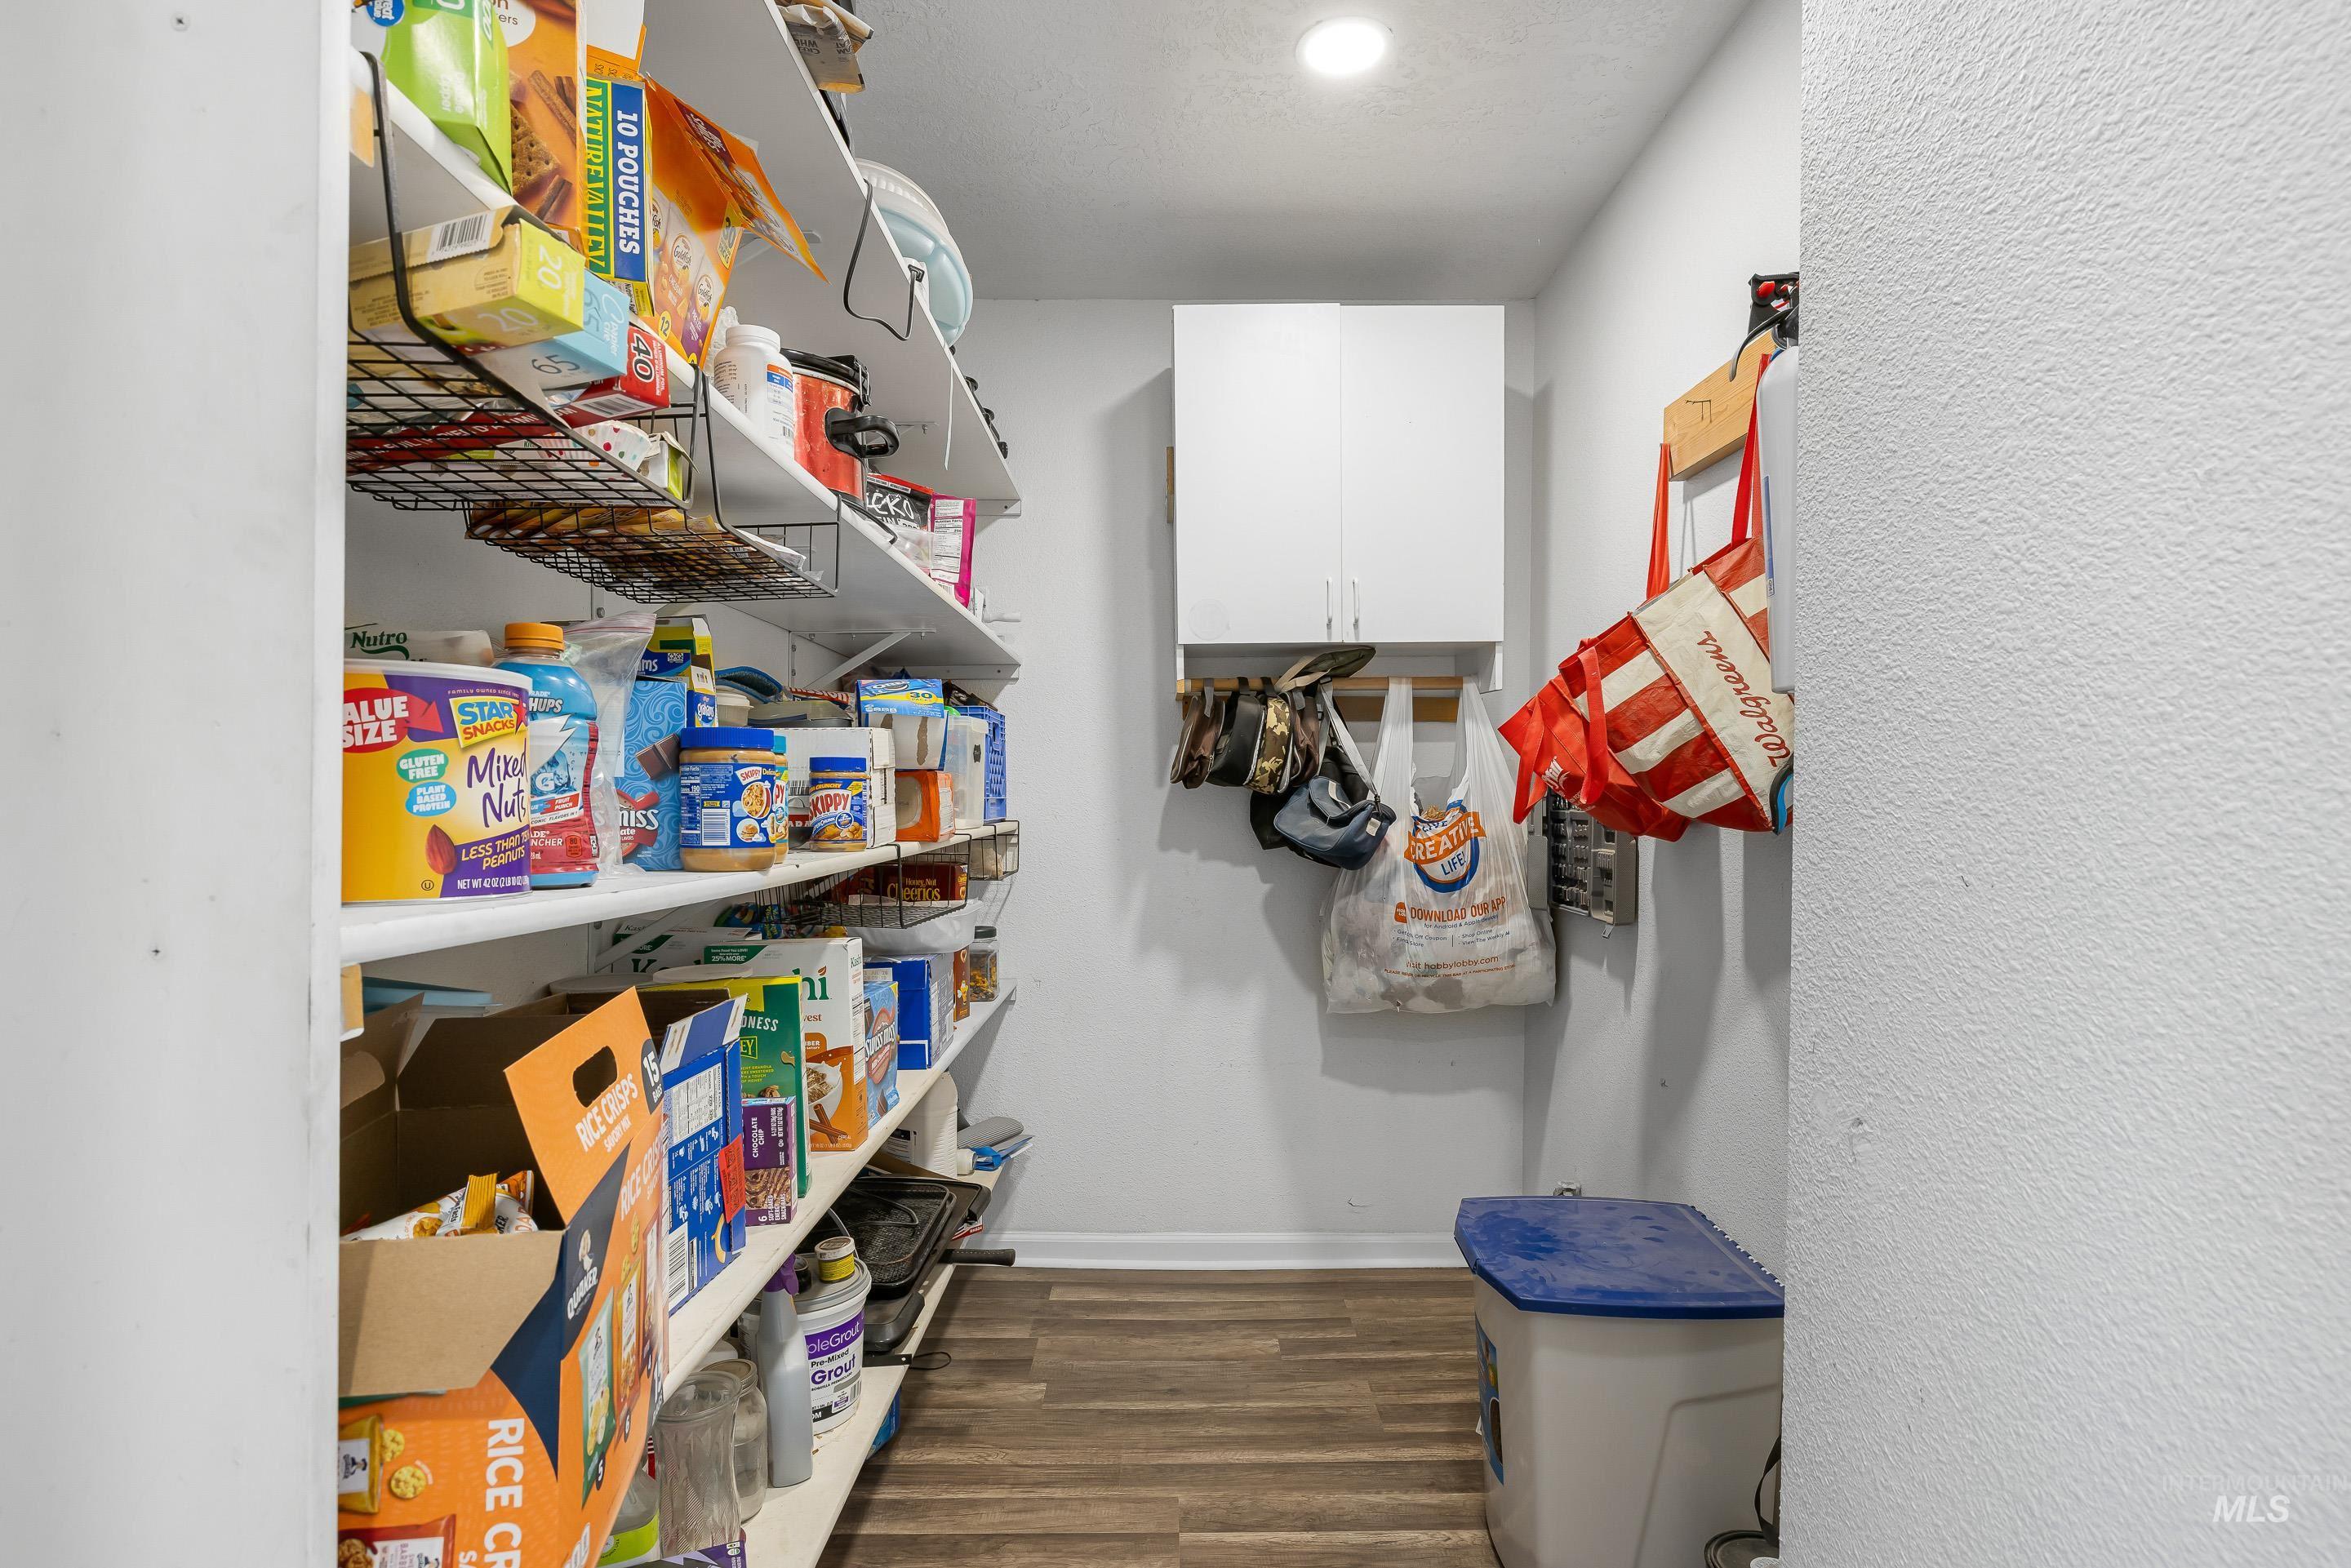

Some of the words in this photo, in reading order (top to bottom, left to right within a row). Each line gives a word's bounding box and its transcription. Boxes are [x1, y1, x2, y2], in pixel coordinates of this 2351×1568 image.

[586, 87, 605, 178] NATURE
[616, 109, 639, 138] 10
[616, 140, 641, 255] POUCHES
[586, 181, 607, 273] VALLEY
[537, 244, 563, 290] 20
[673, 244, 693, 267] Goldfish
[696, 282, 713, 304] Goldfish
[477, 307, 540, 331] 20
[661, 315, 670, 337] 12
[531, 354, 581, 375] 65
[630, 331, 656, 384] 40
[352, 631, 407, 649] Nutro
[498, 688, 512, 696] SINCE
[1696, 630, 1791, 768] Walgreens
[343, 695, 410, 724] ALUE
[457, 700, 515, 726] STAR
[696, 702, 716, 721] grahams
[342, 719, 398, 748] SIZE
[462, 718, 516, 741] SNACKS
[399, 753, 446, 771] GLUTEN
[408, 765, 439, 780] FREE
[466, 737, 528, 789] Mixed
[740, 768, 762, 782] SKIPPY
[816, 783, 842, 791] CRUNCHY
[416, 784, 447, 797] PLANT
[416, 792, 447, 806] BASED
[482, 777, 527, 828] Nuts
[554, 797, 571, 806] FRUIT
[412, 800, 451, 814] PROTEIN
[554, 802, 573, 811] PUNCH
[809, 793, 850, 822] SKIPPY
[461, 842, 493, 862] LESS
[495, 833, 521, 853] THAN
[1410, 815, 1479, 860] CREATIVE
[482, 845, 526, 871] PEANUTS
[1440, 851, 1468, 876] LIFE!
[457, 878, 471, 890] NET
[472, 877, 482, 889] WT
[482, 877, 491, 888] 42
[491, 877, 499, 887] OZ
[905, 877, 923, 887] Honey
[925, 877, 937, 886] Nut
[1411, 907, 1467, 923] DOWNLOAD
[1470, 902, 1490, 917] OUR
[1491, 896, 1507, 913] APP
[1464, 919, 1480, 927] Apple
[1487, 934, 1504, 942] Weekly
[1424, 956, 1500, 971] hobbylobby.com
[642, 1050, 660, 1087] 15
[652, 1083, 663, 1104] BAGS
[575, 1105, 607, 1153] RICE
[600, 1073, 638, 1126] CRISPS
[603, 1122, 624, 1153] SAVORY
[621, 1116, 633, 1137] MIX
[752, 1117, 760, 1159] CHOCOLATE
[620, 1160, 642, 1222] RICE
[567, 1267, 599, 1320] QUAKER
[811, 1348, 850, 1368] Pre-Mixed
[811, 1354, 856, 1385] Grout
[485, 1418, 525, 1512] RICE
